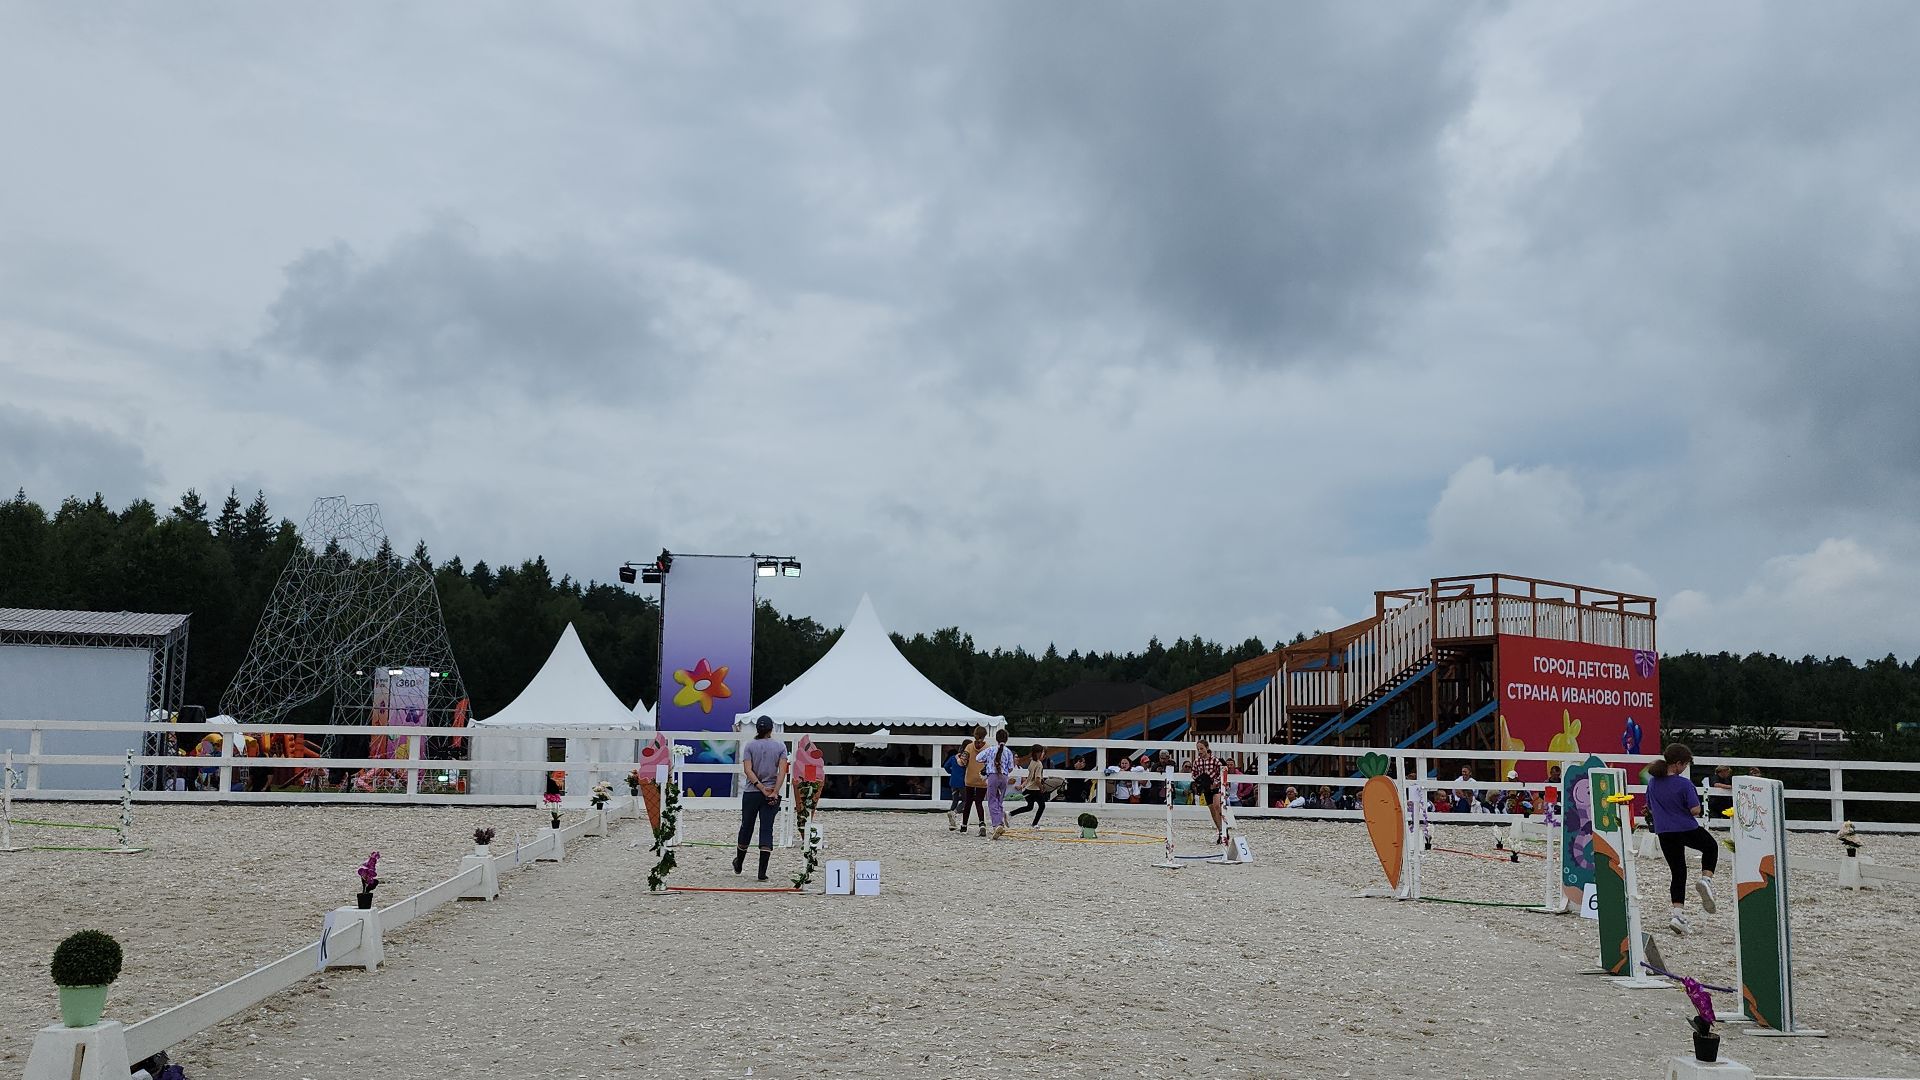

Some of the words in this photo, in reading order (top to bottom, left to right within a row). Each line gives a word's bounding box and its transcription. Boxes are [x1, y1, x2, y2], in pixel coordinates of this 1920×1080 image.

[1533, 656, 1576, 679] ГОРОД
[1577, 660, 1630, 680] ДЕТСТВА
[1507, 683, 1559, 702] СТРАНА
[1562, 686, 1621, 706] ИВАНОВО
[1623, 691, 1654, 708] ПОЛЕ
[1240, 842, 1248, 856] 5
[835, 868, 841, 888] 1
[1588, 893, 1600, 911] 6
